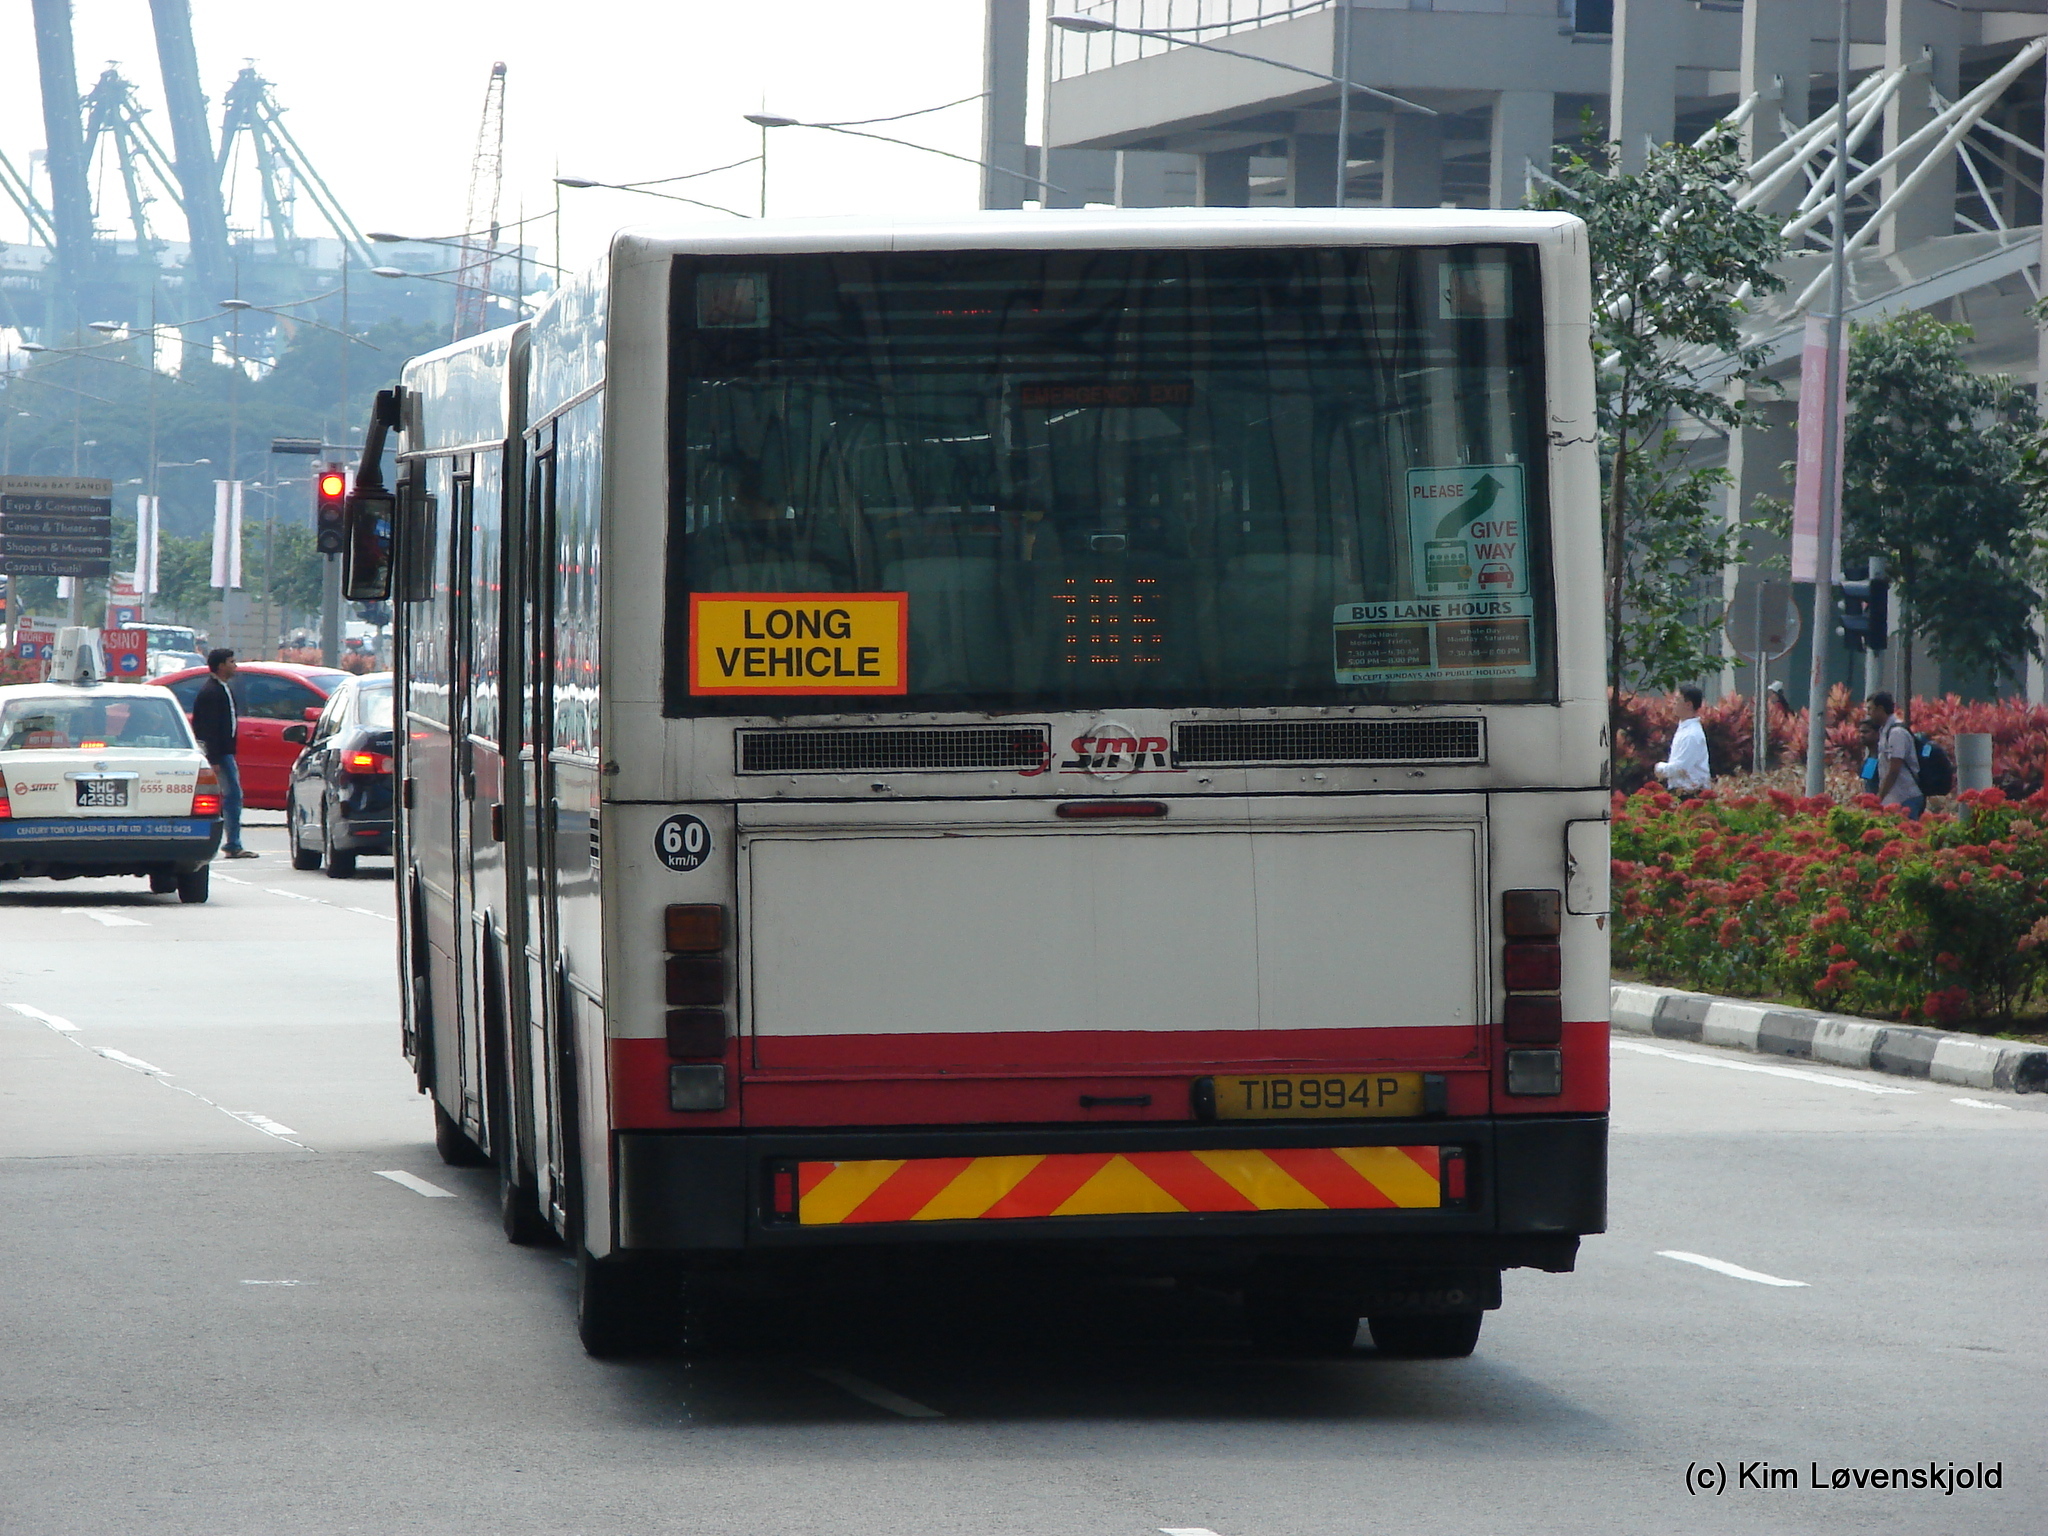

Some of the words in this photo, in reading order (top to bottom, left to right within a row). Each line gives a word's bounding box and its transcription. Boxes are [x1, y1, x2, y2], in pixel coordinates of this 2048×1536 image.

[1022, 385, 1140, 405] EMERGENCY
[1151, 383, 1191, 403] EXIT
[7, 481, 48, 489] MARINA
[51, 481, 71, 489] BAY
[75, 482, 108, 491] SANDS
[1413, 484, 1464, 499] PLEASE
[6, 499, 31, 511] Expo
[34, 500, 42, 511] &
[46, 500, 102, 513] Convention
[6, 520, 40, 532] Casino
[42, 521, 51, 532] &
[1470, 521, 1519, 539] GIVE
[50, 542, 59, 552] &
[61, 543, 103, 554] Museum
[1474, 542, 1517, 561] WAY
[4, 561, 44, 572] Carpark
[47, 562, 82, 573] (South)
[1352, 605, 1388, 620] BUS
[1394, 603, 1442, 618] LANE
[1448, 601, 1513, 617] HOURS
[743, 608, 851, 640] LONG
[19, 631, 44, 643] MORE
[101, 631, 140, 649] ASINO
[1507, 647, 1521, 655] PM
[716, 646, 880, 677] VEHICLE
[1353, 673, 1382, 681] EXCEPT
[1385, 672, 1423, 680] SUNDAYS
[30, 782, 59, 792] SMRT
[87, 781, 115, 793] SHC
[140, 784, 163, 793] 6555
[166, 783, 193, 793] 8888
[79, 793, 125, 806] 4239S
[16, 826, 49, 835] CENTURY
[50, 825, 75, 834] TOKYO
[76, 824, 106, 833] LEASING
[663, 822, 704, 853] 60
[668, 855, 699, 866] km/h
[1238, 1077, 1399, 1111] TIB994P
